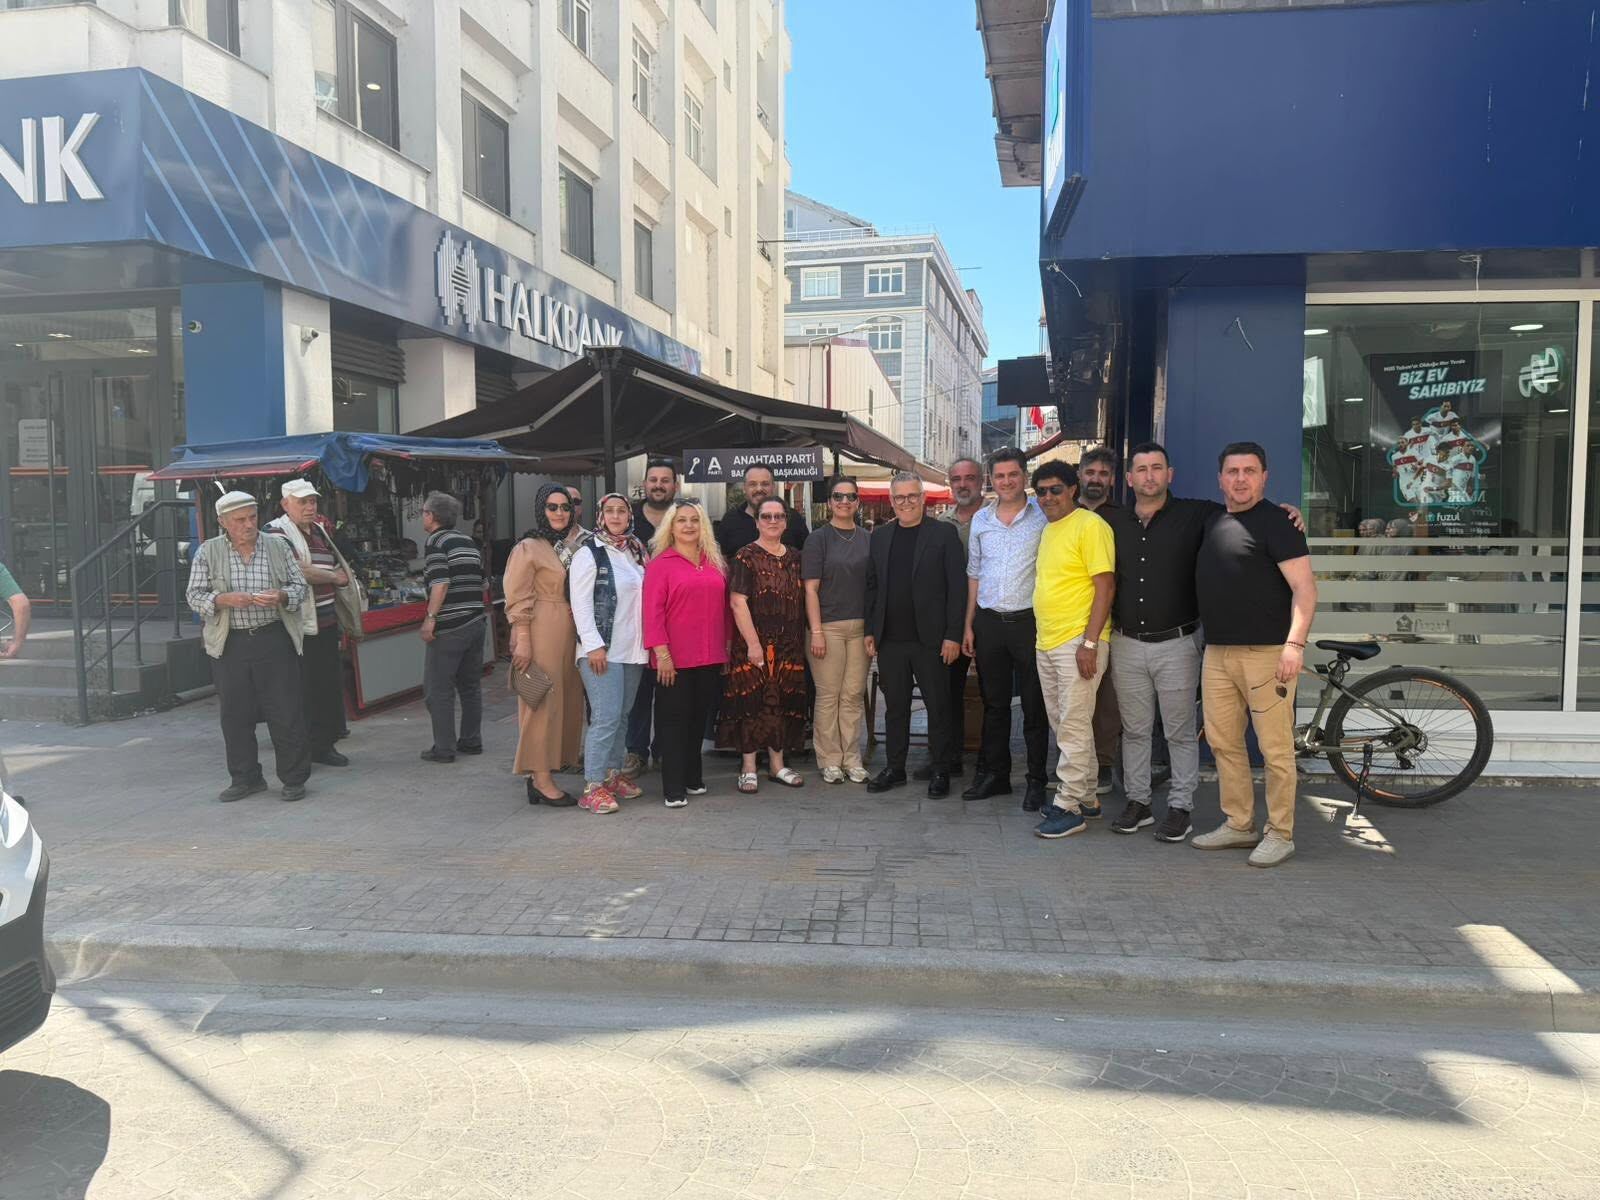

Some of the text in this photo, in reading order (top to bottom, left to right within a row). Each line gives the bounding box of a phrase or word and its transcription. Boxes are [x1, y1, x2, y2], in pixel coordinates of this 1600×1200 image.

[1426, 368, 1449, 382] EV
[708, 456, 722, 470] A
[733, 453, 815, 465] ANAHTAR PARTİ
[774, 466, 818, 478] BAŞKANLIĞI
[1437, 512, 1460, 521] fuzul
